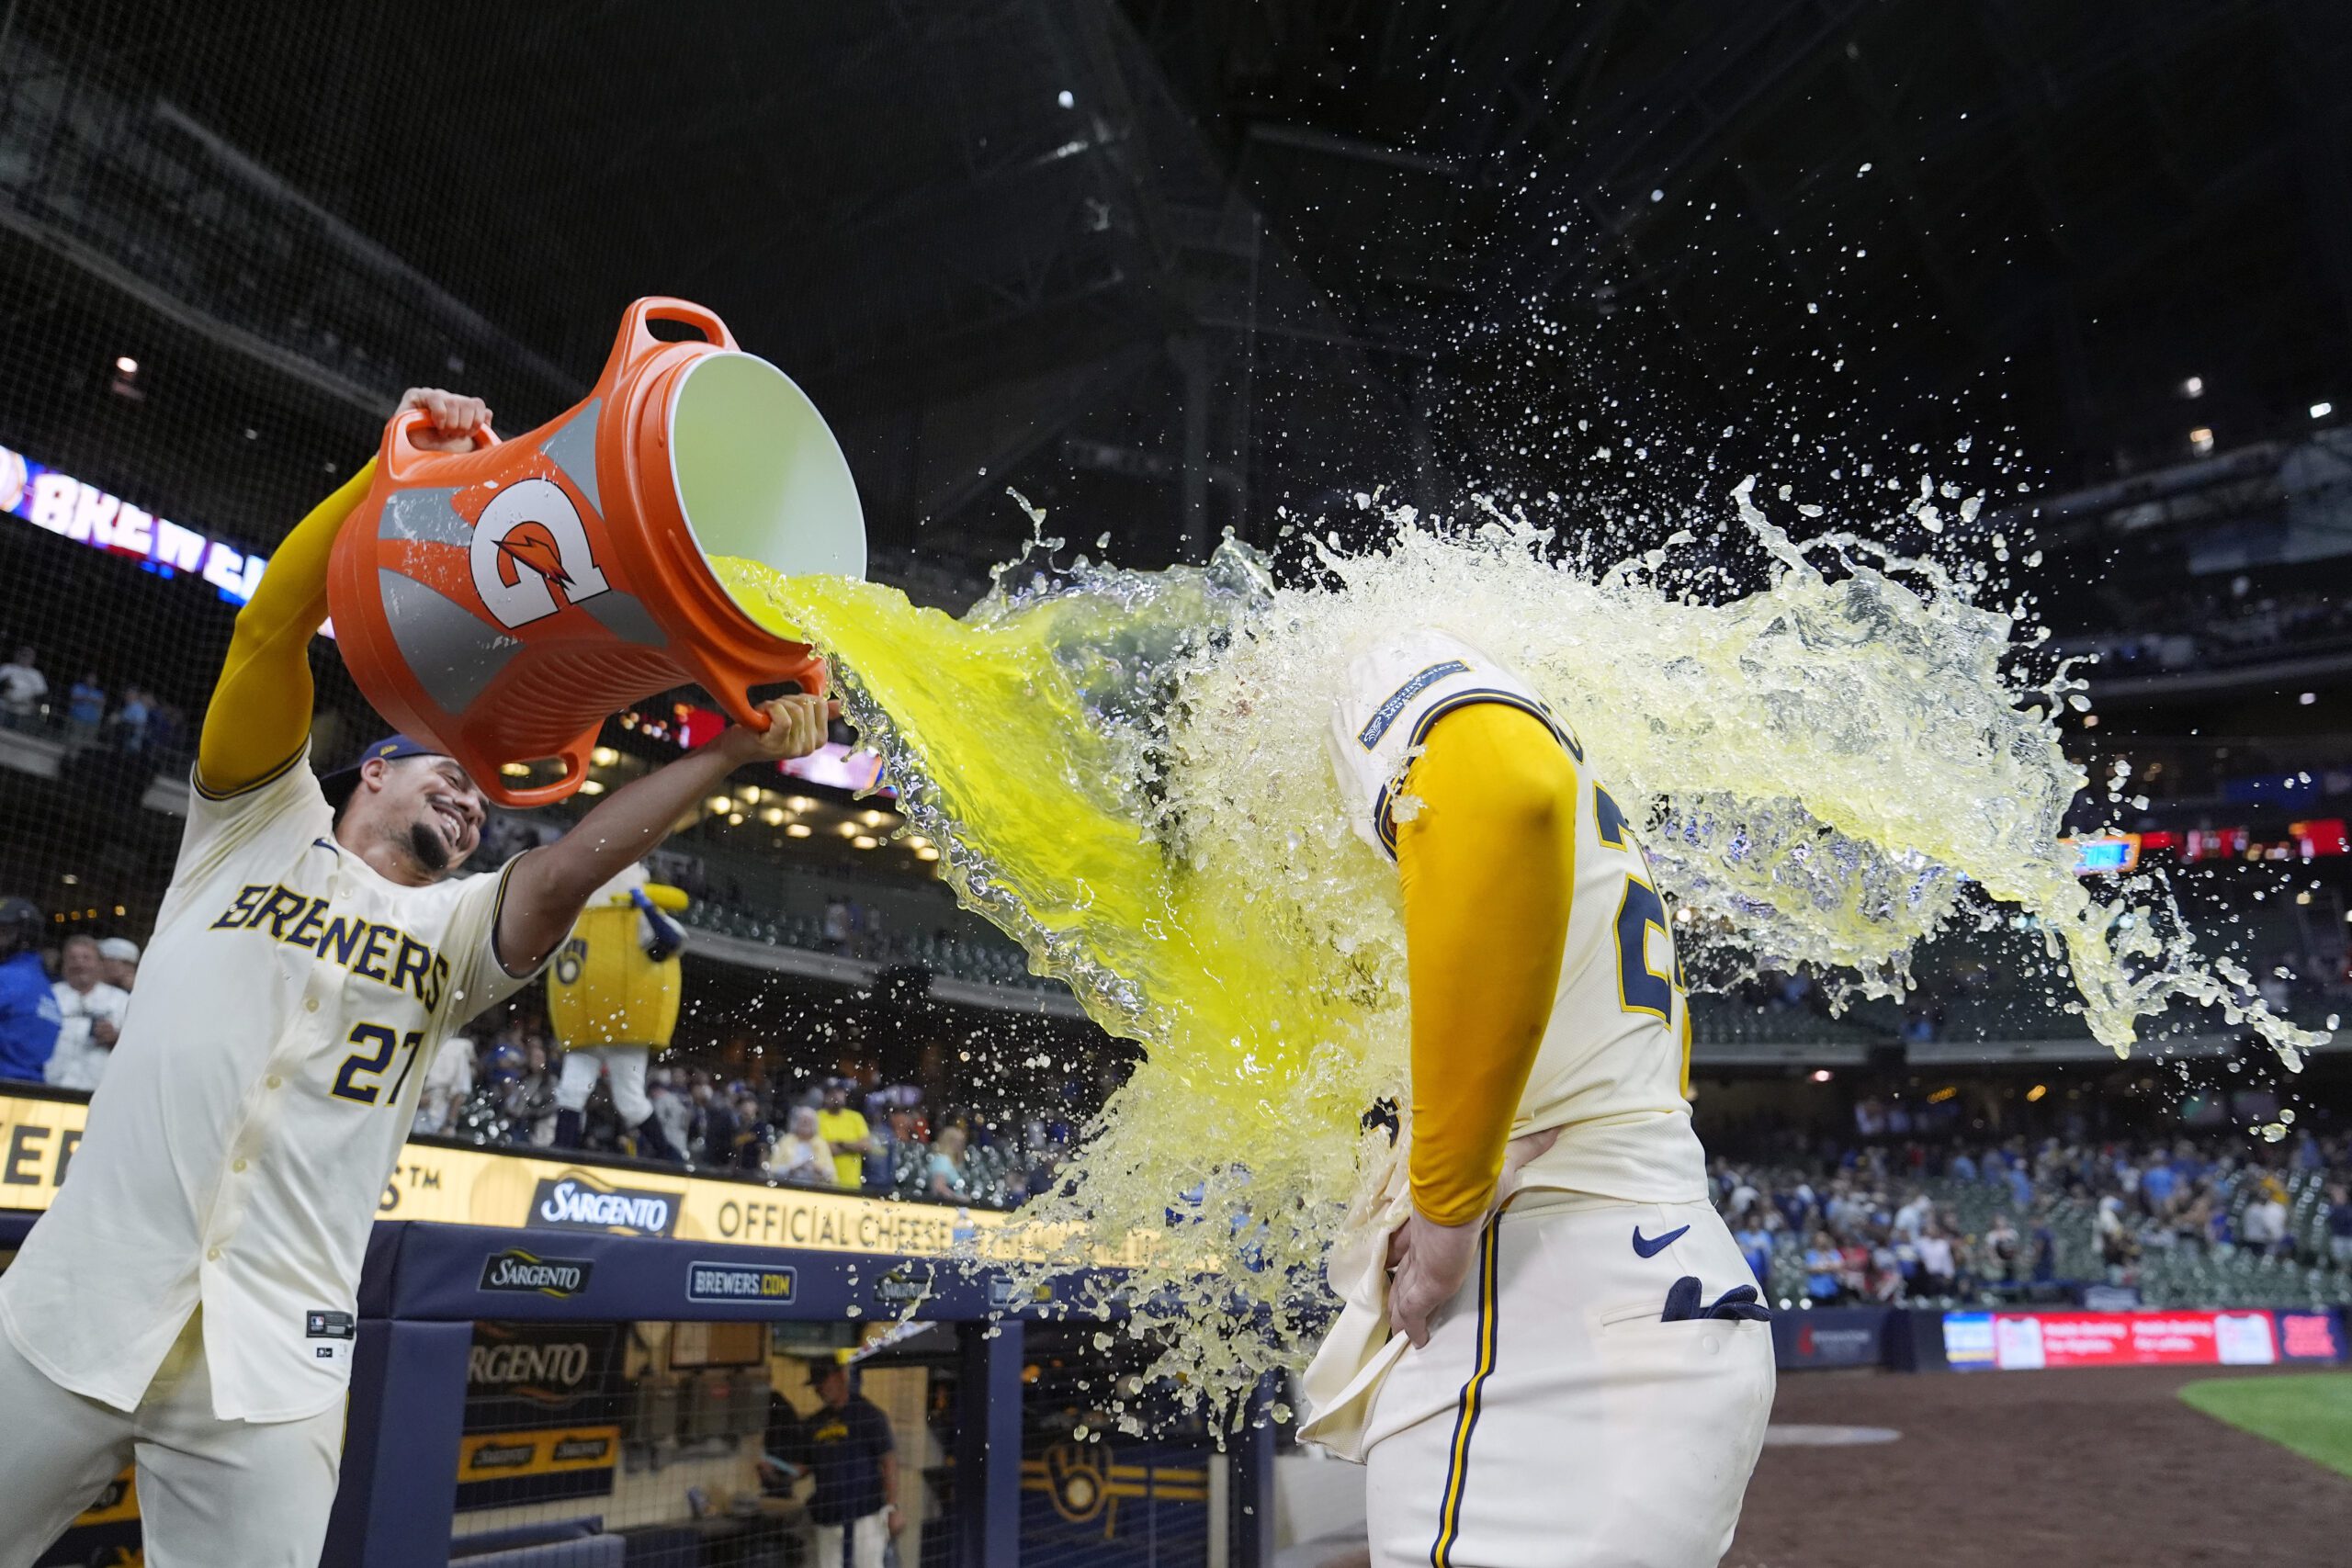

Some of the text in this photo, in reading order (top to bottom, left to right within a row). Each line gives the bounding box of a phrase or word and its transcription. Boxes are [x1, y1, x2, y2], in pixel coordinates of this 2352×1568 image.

[329, 1021, 434, 1106] 27
[540, 1182, 668, 1232] SARGENTO
[718, 1201, 848, 1246] OFFICIAL
[858, 1214, 952, 1252] CHEESE
[491, 1258, 582, 1291] SARGENTO
[695, 1270, 790, 1296] BREWERS.COM
